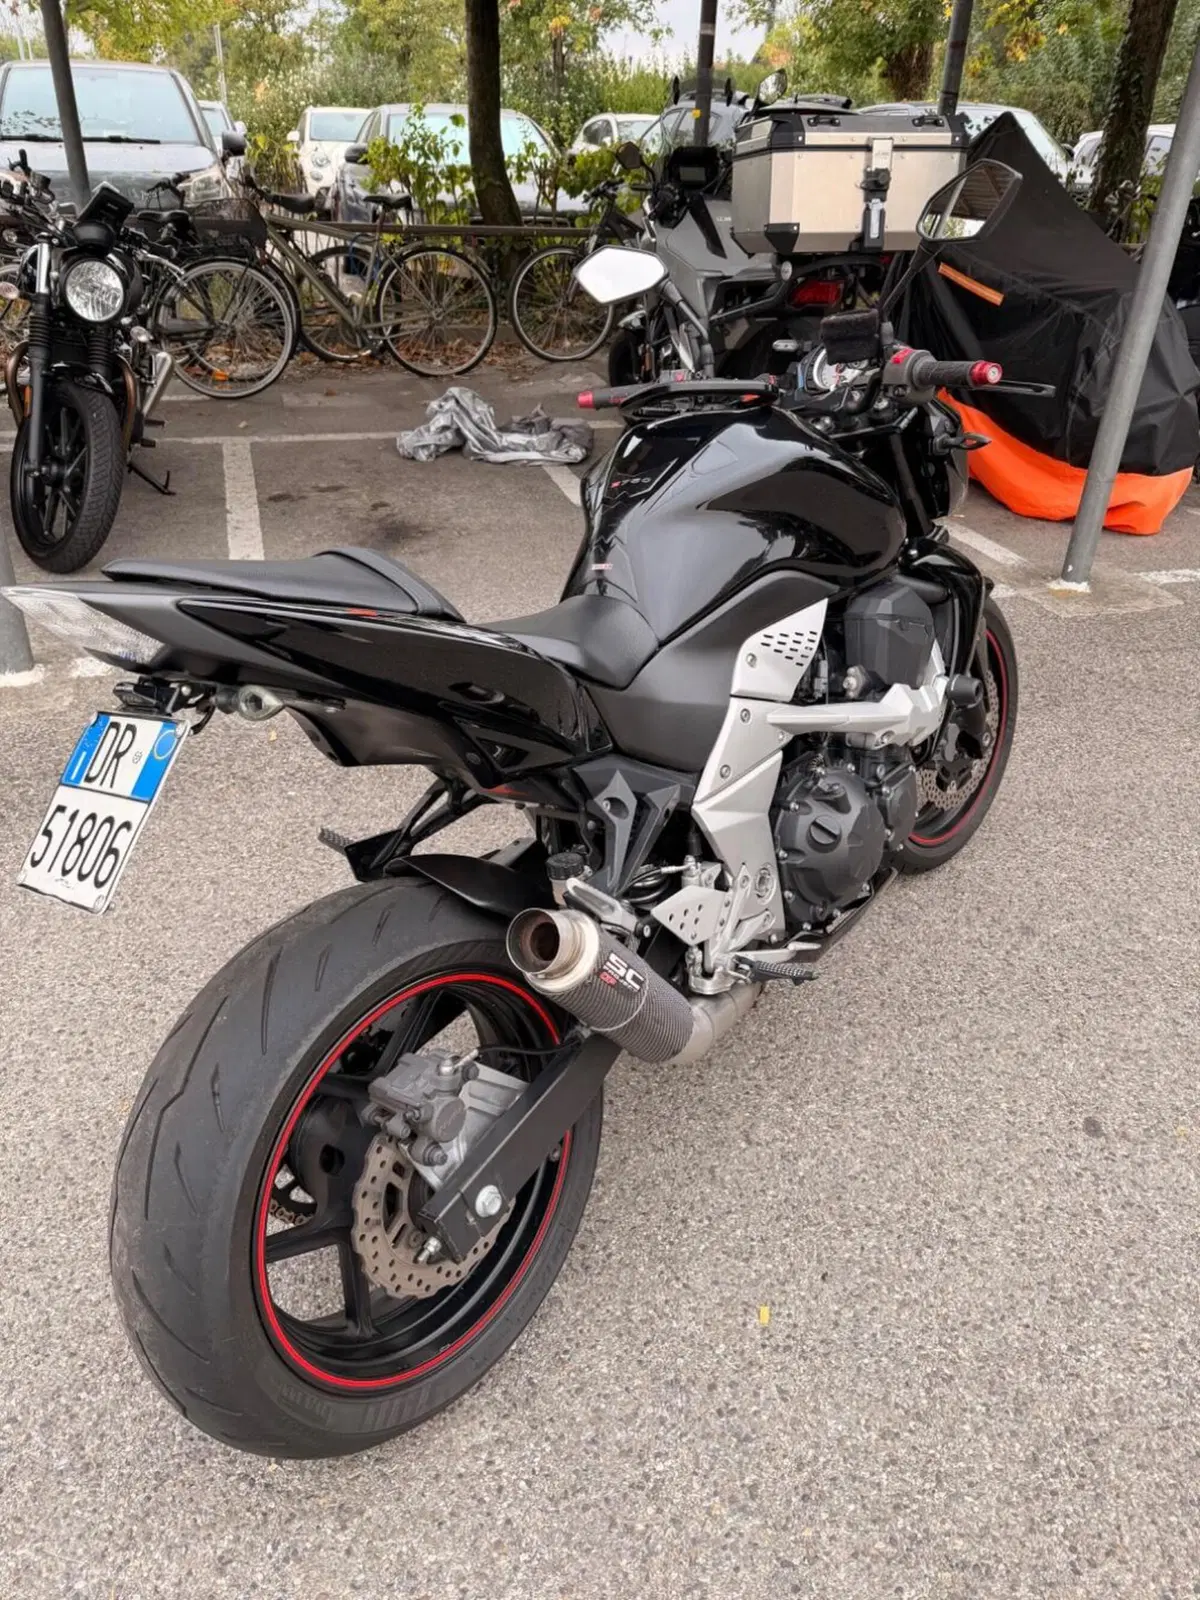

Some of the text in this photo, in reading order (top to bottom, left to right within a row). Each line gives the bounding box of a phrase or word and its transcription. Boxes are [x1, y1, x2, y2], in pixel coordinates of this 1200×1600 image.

[84, 721, 138, 789] DR
[30, 804, 133, 889] 51806
[609, 953, 645, 991] SC
